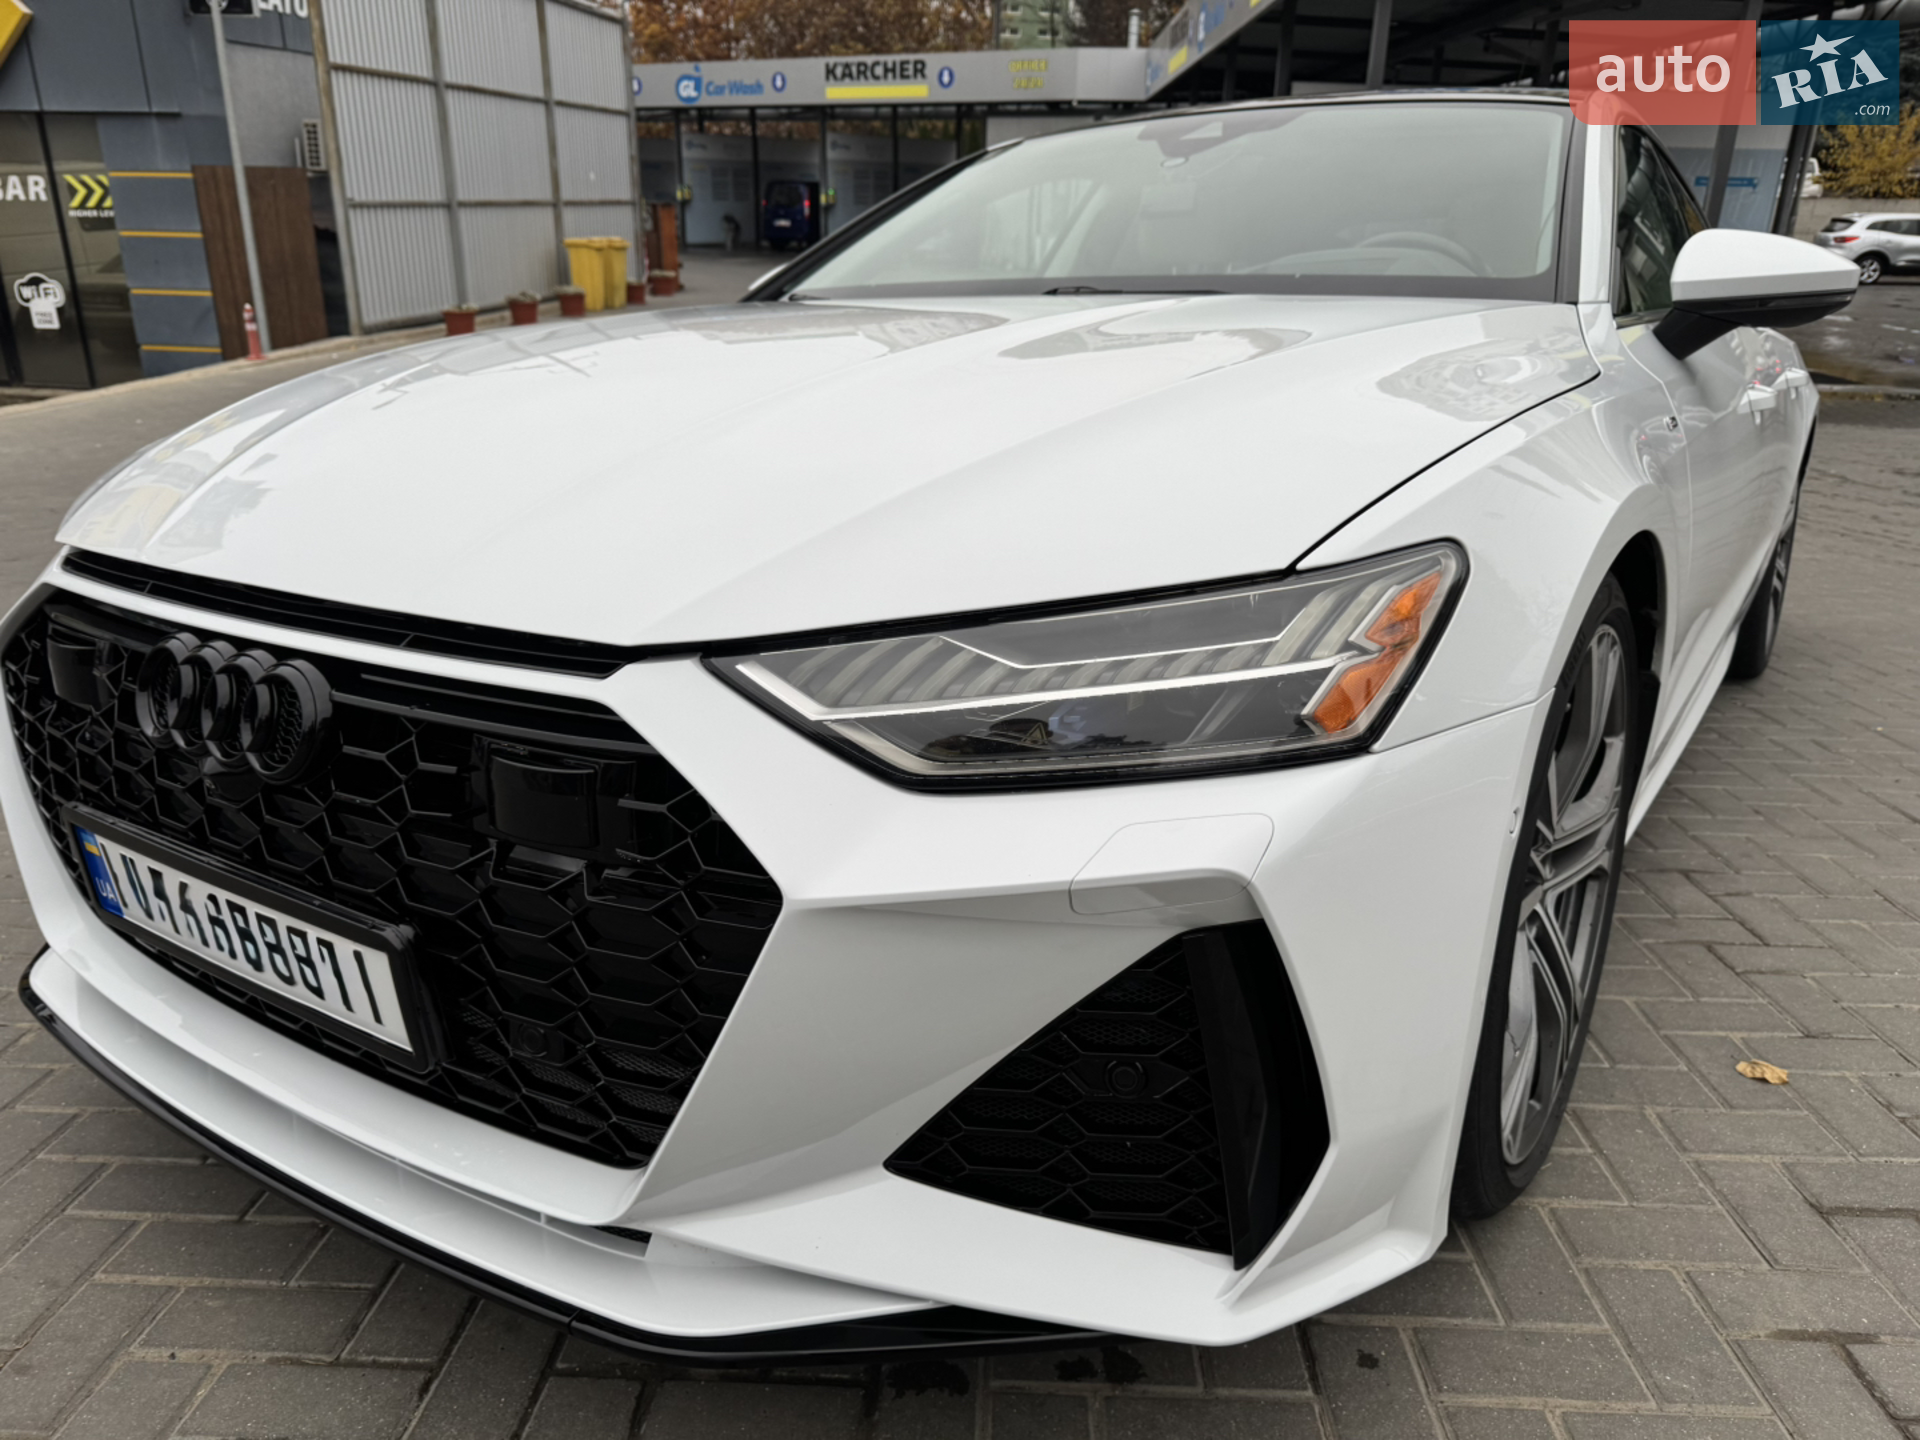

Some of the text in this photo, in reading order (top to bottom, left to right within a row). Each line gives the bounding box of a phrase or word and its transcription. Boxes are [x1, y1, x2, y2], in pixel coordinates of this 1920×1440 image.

[824, 60, 927, 82] KÄRCHER
[705, 81, 726, 97] Car
[728, 79, 764, 96] Wash
[0, 174, 48, 202] AR
[96, 878, 117, 901] UA
